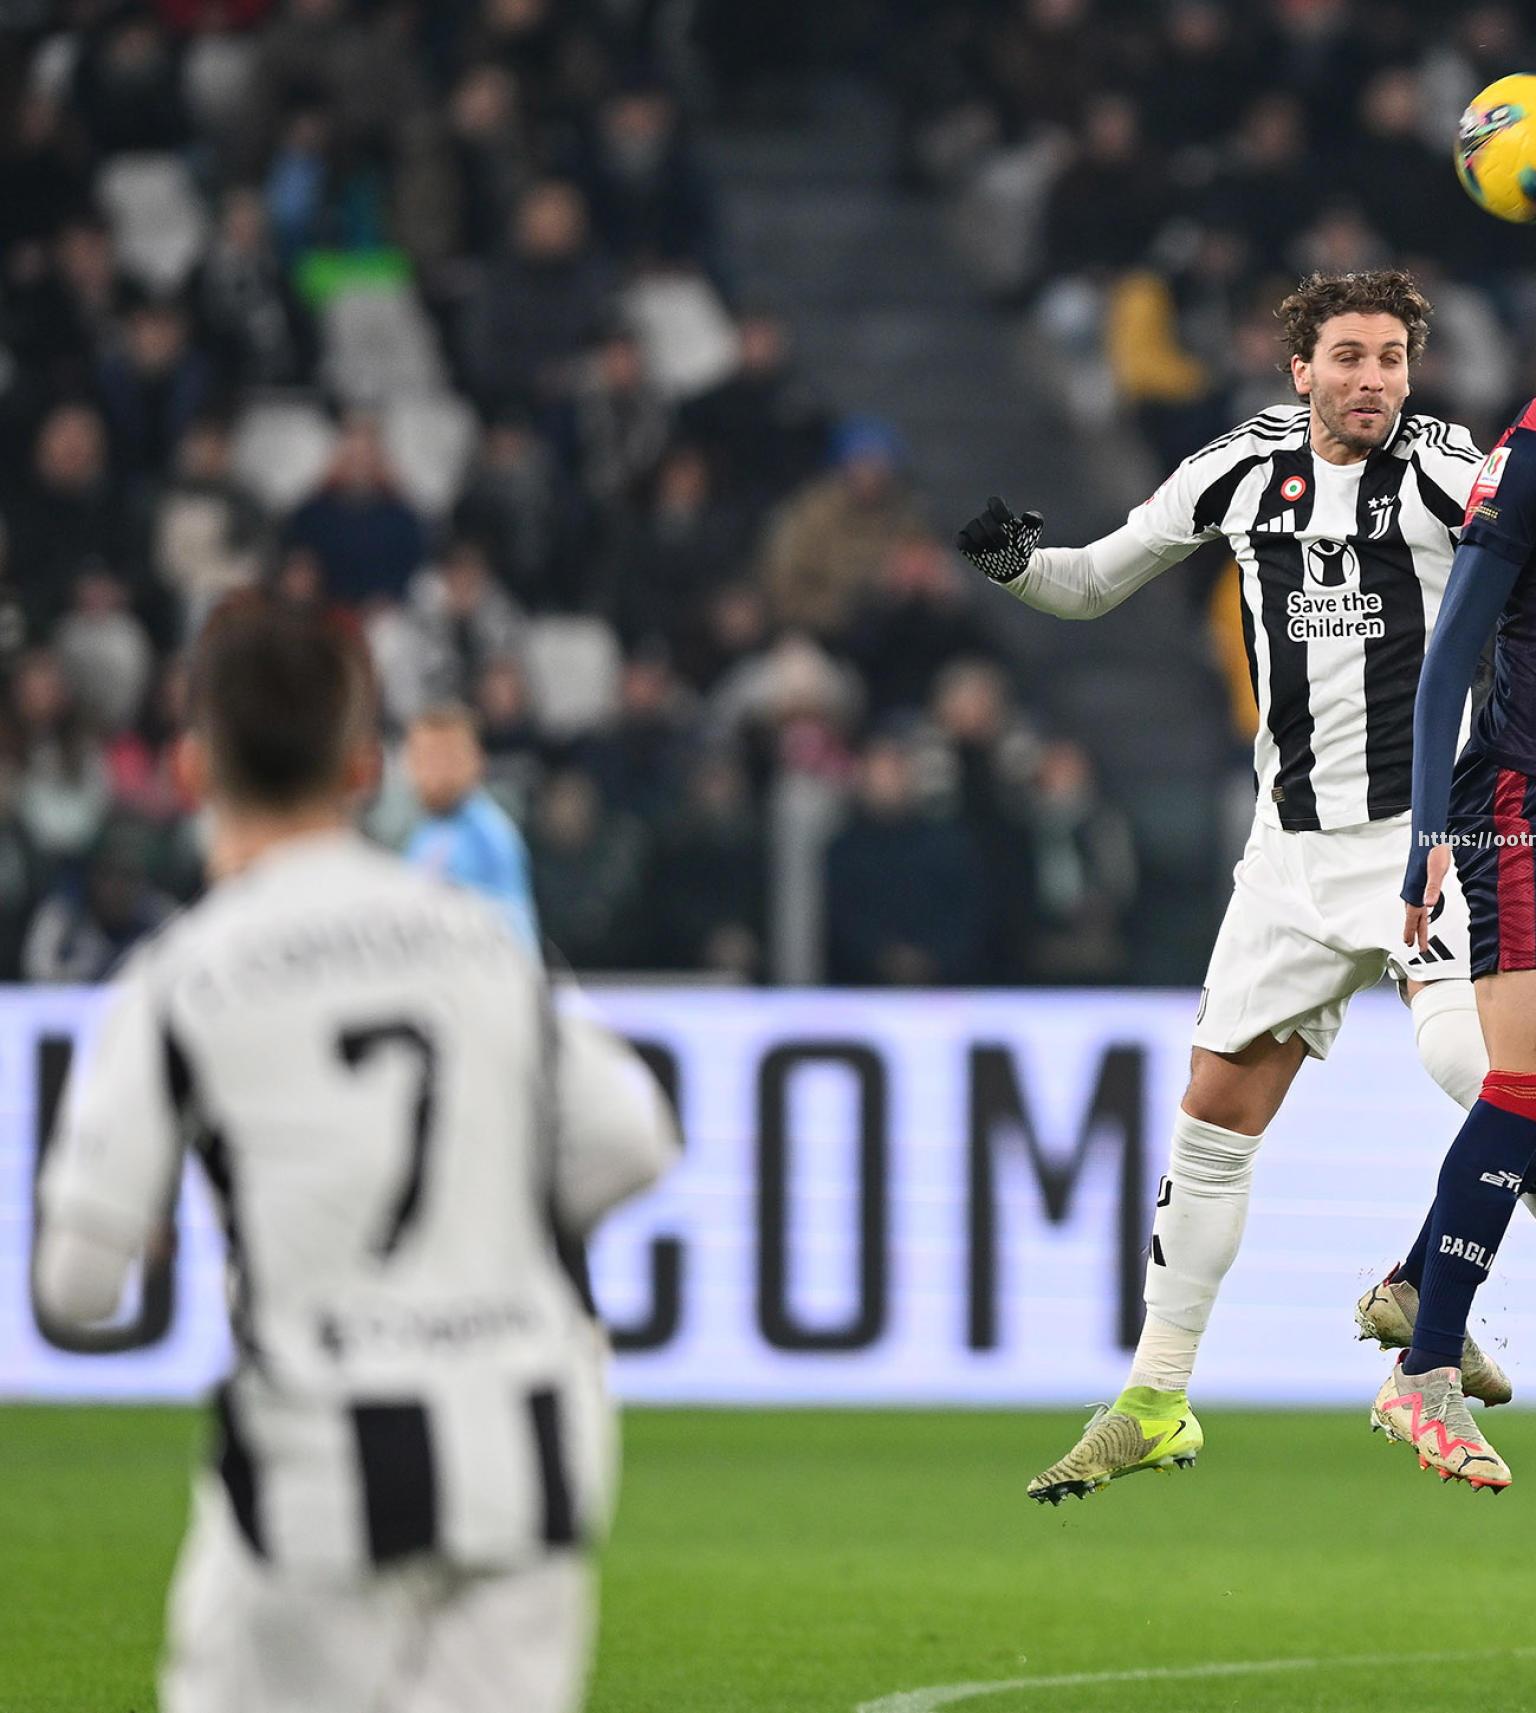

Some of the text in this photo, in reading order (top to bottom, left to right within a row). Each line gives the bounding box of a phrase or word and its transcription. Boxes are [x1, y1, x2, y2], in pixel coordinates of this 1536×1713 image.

[1290, 592, 1379, 613] Save the
[1290, 620, 1382, 638] Children
[337, 1021, 435, 1267] 7
